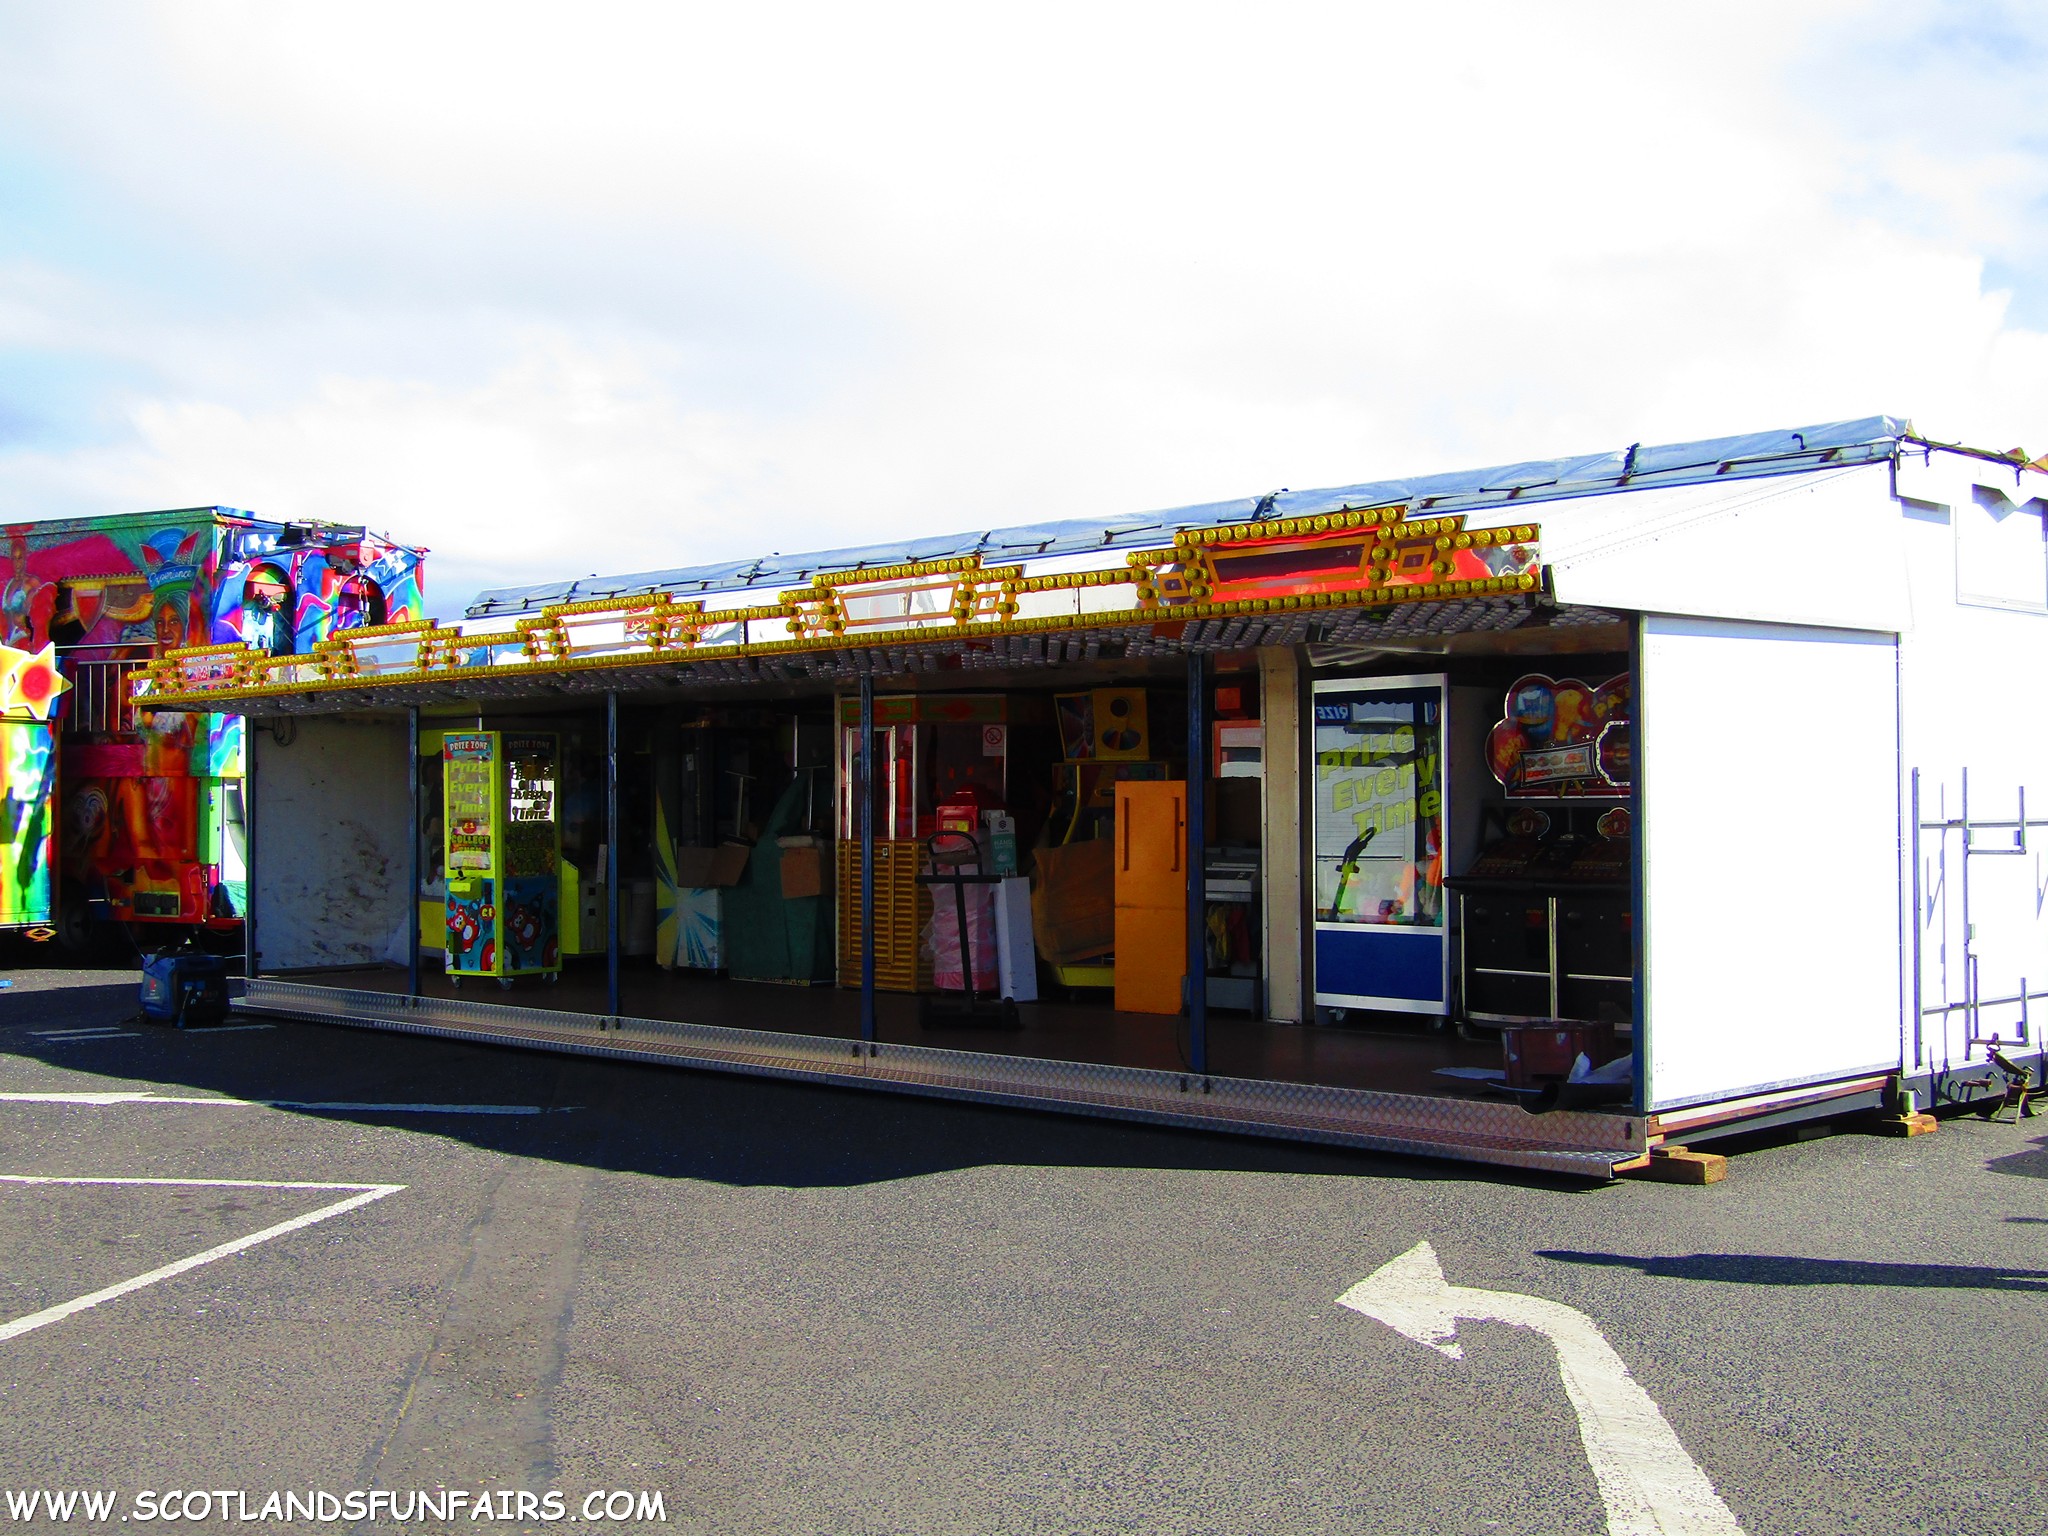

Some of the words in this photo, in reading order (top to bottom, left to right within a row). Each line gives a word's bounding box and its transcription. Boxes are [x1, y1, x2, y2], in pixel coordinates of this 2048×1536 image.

[449, 741, 469, 751] PRIZE
[471, 740, 488, 750] ZONE
[1319, 725, 1414, 782] Prize
[450, 760, 489, 773] Prize
[451, 782, 489, 795] Every
[1332, 754, 1437, 813] Every
[454, 800, 485, 813] Time
[1353, 791, 1441, 836] Time
[451, 835, 490, 844] COLLECT
